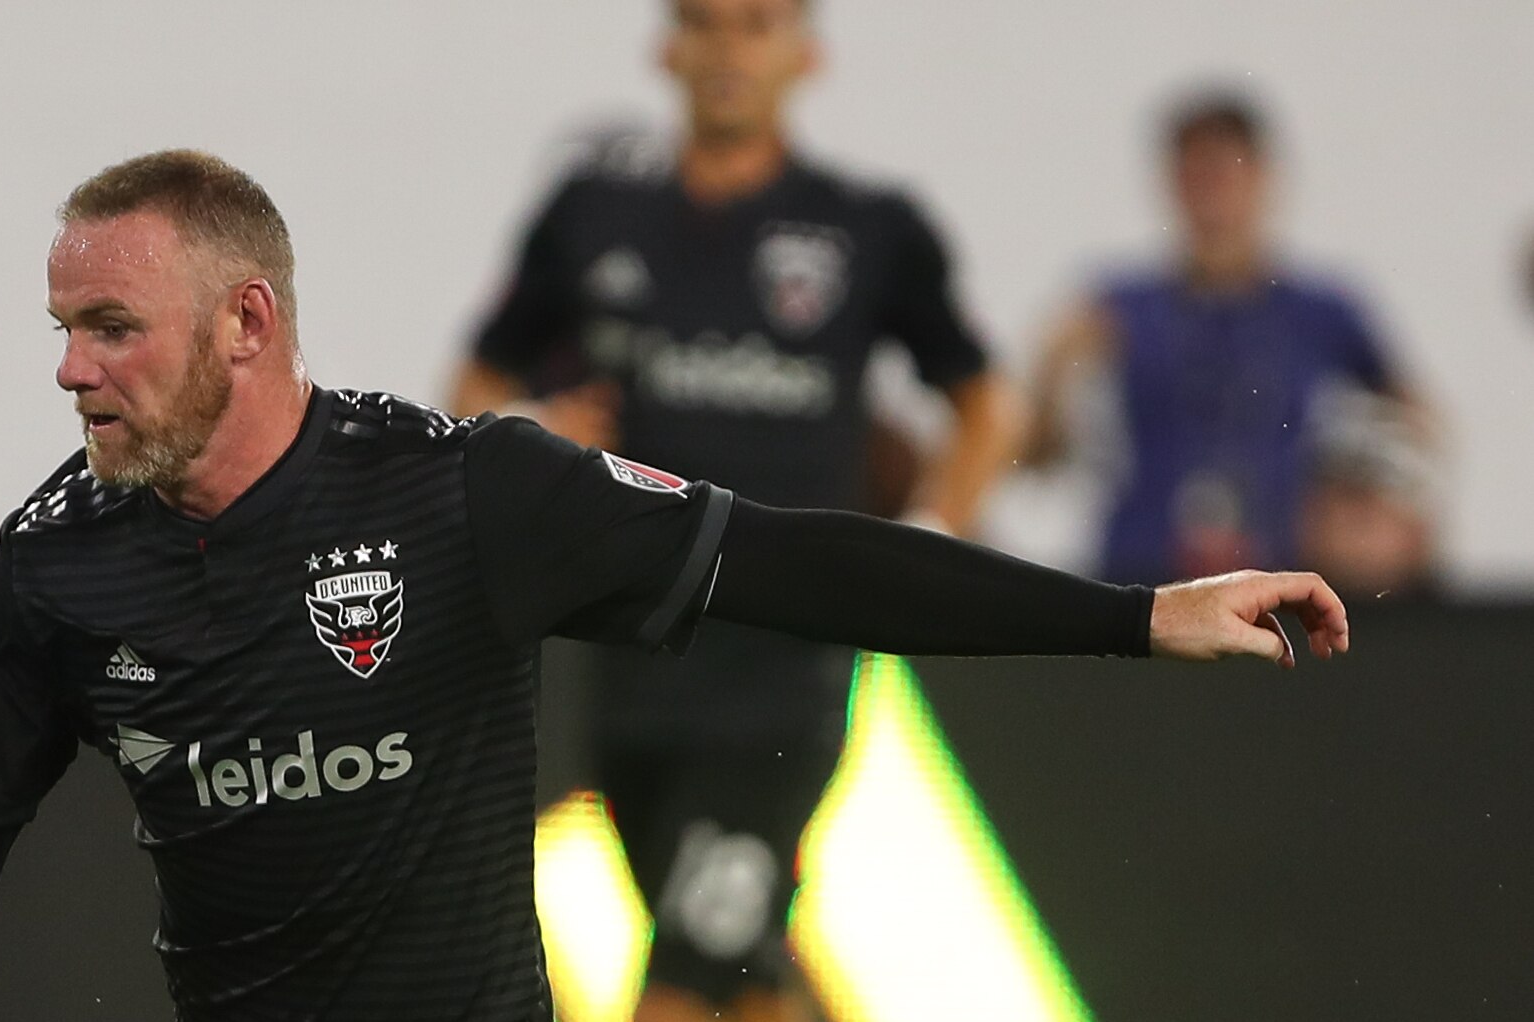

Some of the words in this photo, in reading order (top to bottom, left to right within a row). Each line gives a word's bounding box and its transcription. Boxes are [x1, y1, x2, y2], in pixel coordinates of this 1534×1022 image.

[341, 575, 388, 594] UNITED
[106, 662, 156, 682] adidas
[187, 729, 413, 808] leidos
